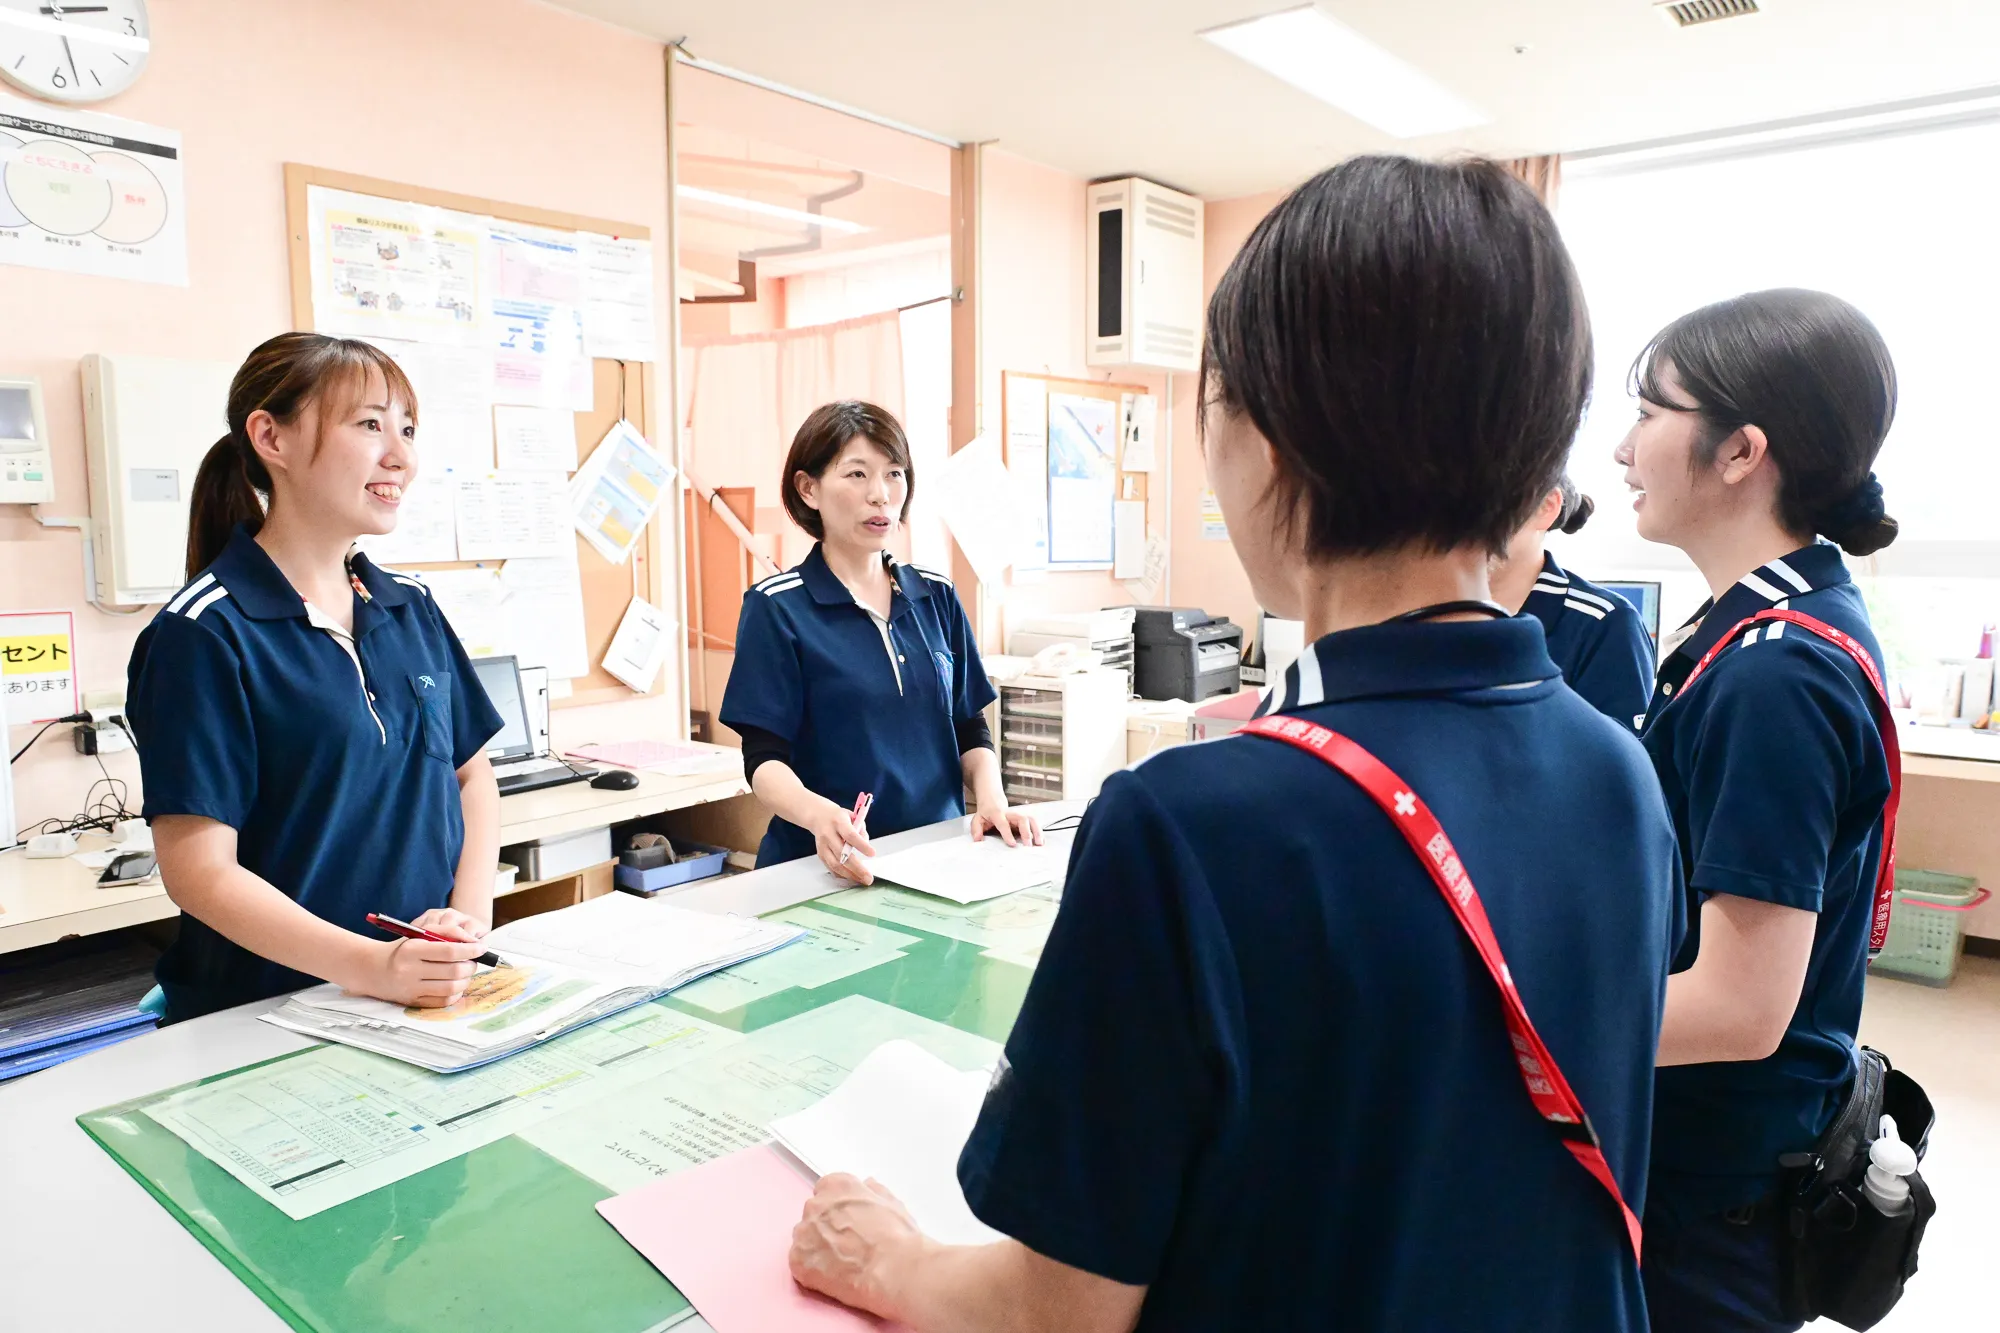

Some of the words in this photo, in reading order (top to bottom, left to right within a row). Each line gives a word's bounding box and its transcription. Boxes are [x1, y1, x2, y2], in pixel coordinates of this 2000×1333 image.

[123, 17, 137, 37] 3
[51, 66, 67, 89] 6
[2, 643, 68, 663] セント
[1259, 717, 1334, 749] 医療用
[1426, 832, 1475, 907] 医療用
[1869, 901, 1891, 948] 医療用スタ
